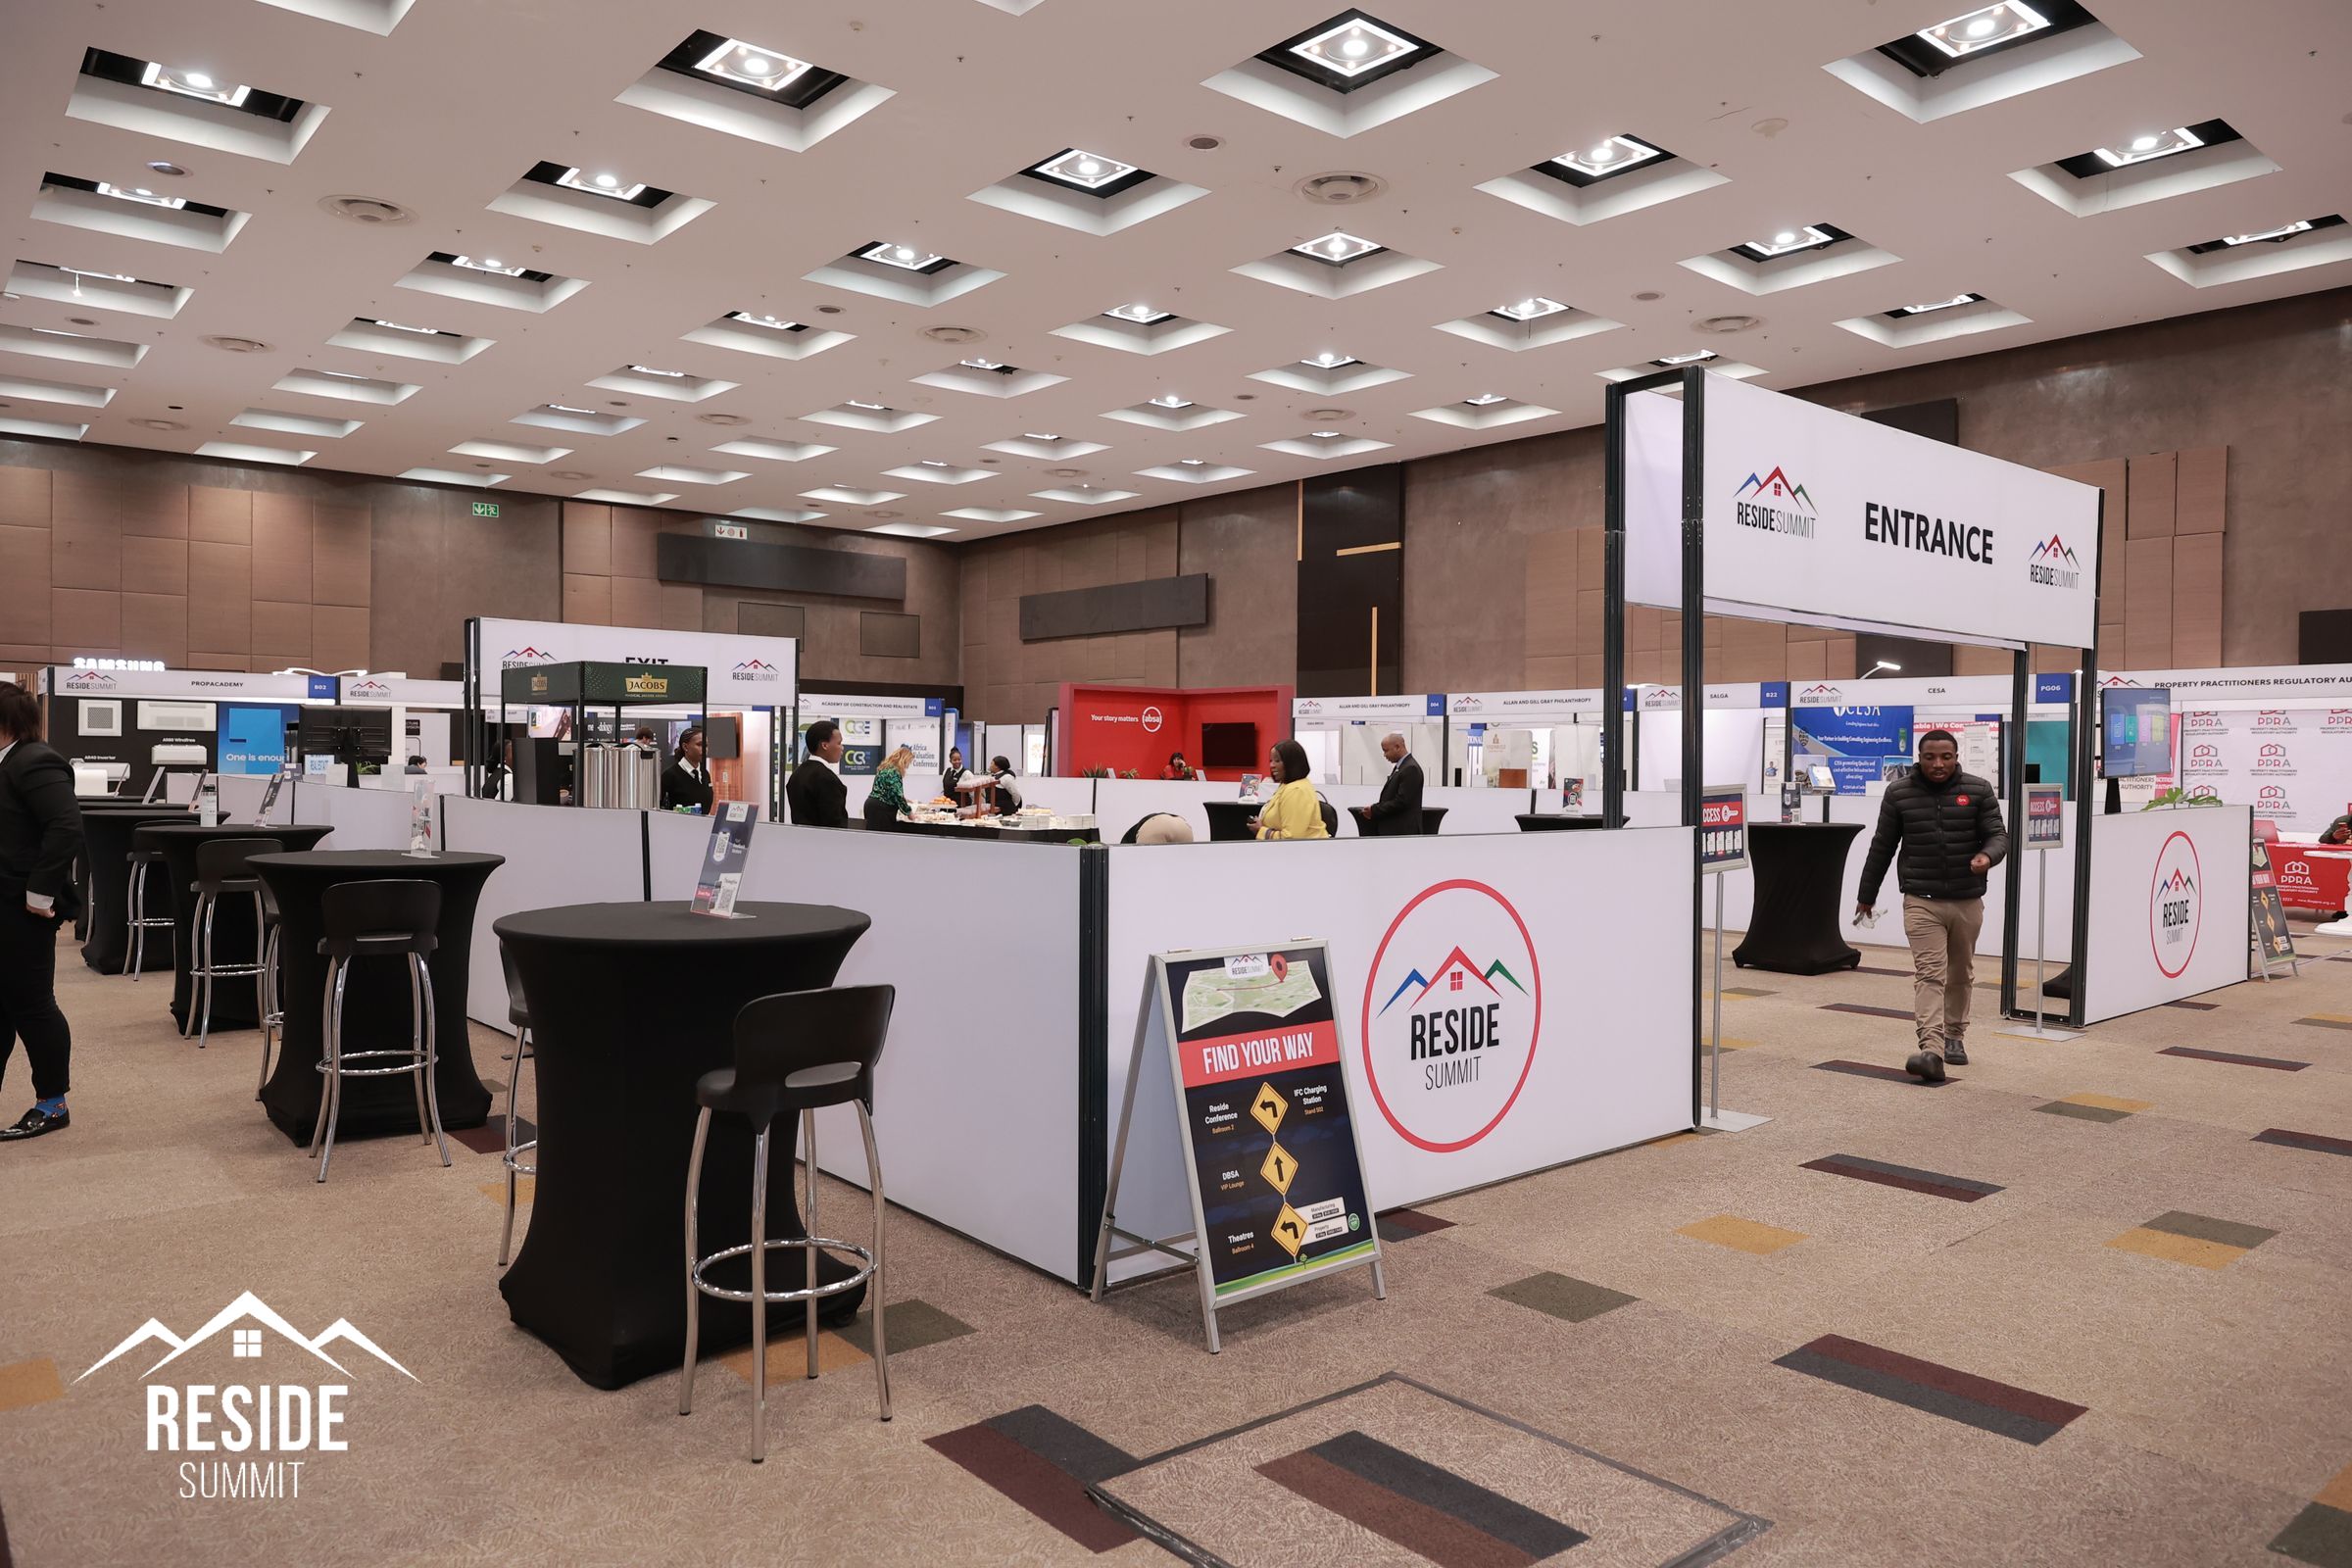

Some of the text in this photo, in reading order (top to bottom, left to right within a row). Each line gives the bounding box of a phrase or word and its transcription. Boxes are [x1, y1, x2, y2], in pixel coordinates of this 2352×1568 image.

[1865, 502, 1993, 565] ENTRANCE
[74, 658, 165, 671] SAMSUNG
[628, 681, 665, 690] JACOBS
[2200, 678, 2272, 687] PRACTITIONERS
[2273, 676, 2335, 685] REGULATORY
[1145, 713, 1160, 722] absa
[2258, 716, 2291, 725] PPRA
[2190, 759, 2223, 767] PPRA
[2257, 759, 2291, 767] PPRA
[2257, 801, 2290, 809] PPRA
[1702, 807, 1721, 822] CCESS
[2280, 875, 2313, 885] PPRA
[2163, 900, 2189, 928] RESIDE
[2166, 928, 2183, 945] SUMMIT
[1410, 1003, 1500, 1061] RESIDE
[1202, 1032, 1313, 1075] FIND YOUR WAY
[1425, 1055, 1482, 1091] SUMMIT
[1294, 1085, 1327, 1097] IFC Charging
[1302, 1096, 1322, 1104] Station
[1208, 1102, 1230, 1112] Reside
[1204, 1112, 1239, 1124] Conference
[1222, 1169, 1240, 1181] DBSA
[1229, 1181, 1245, 1190] Lounge
[1310, 1203, 1336, 1212] Manufacturing
[1227, 1231, 1254, 1244] Theatres
